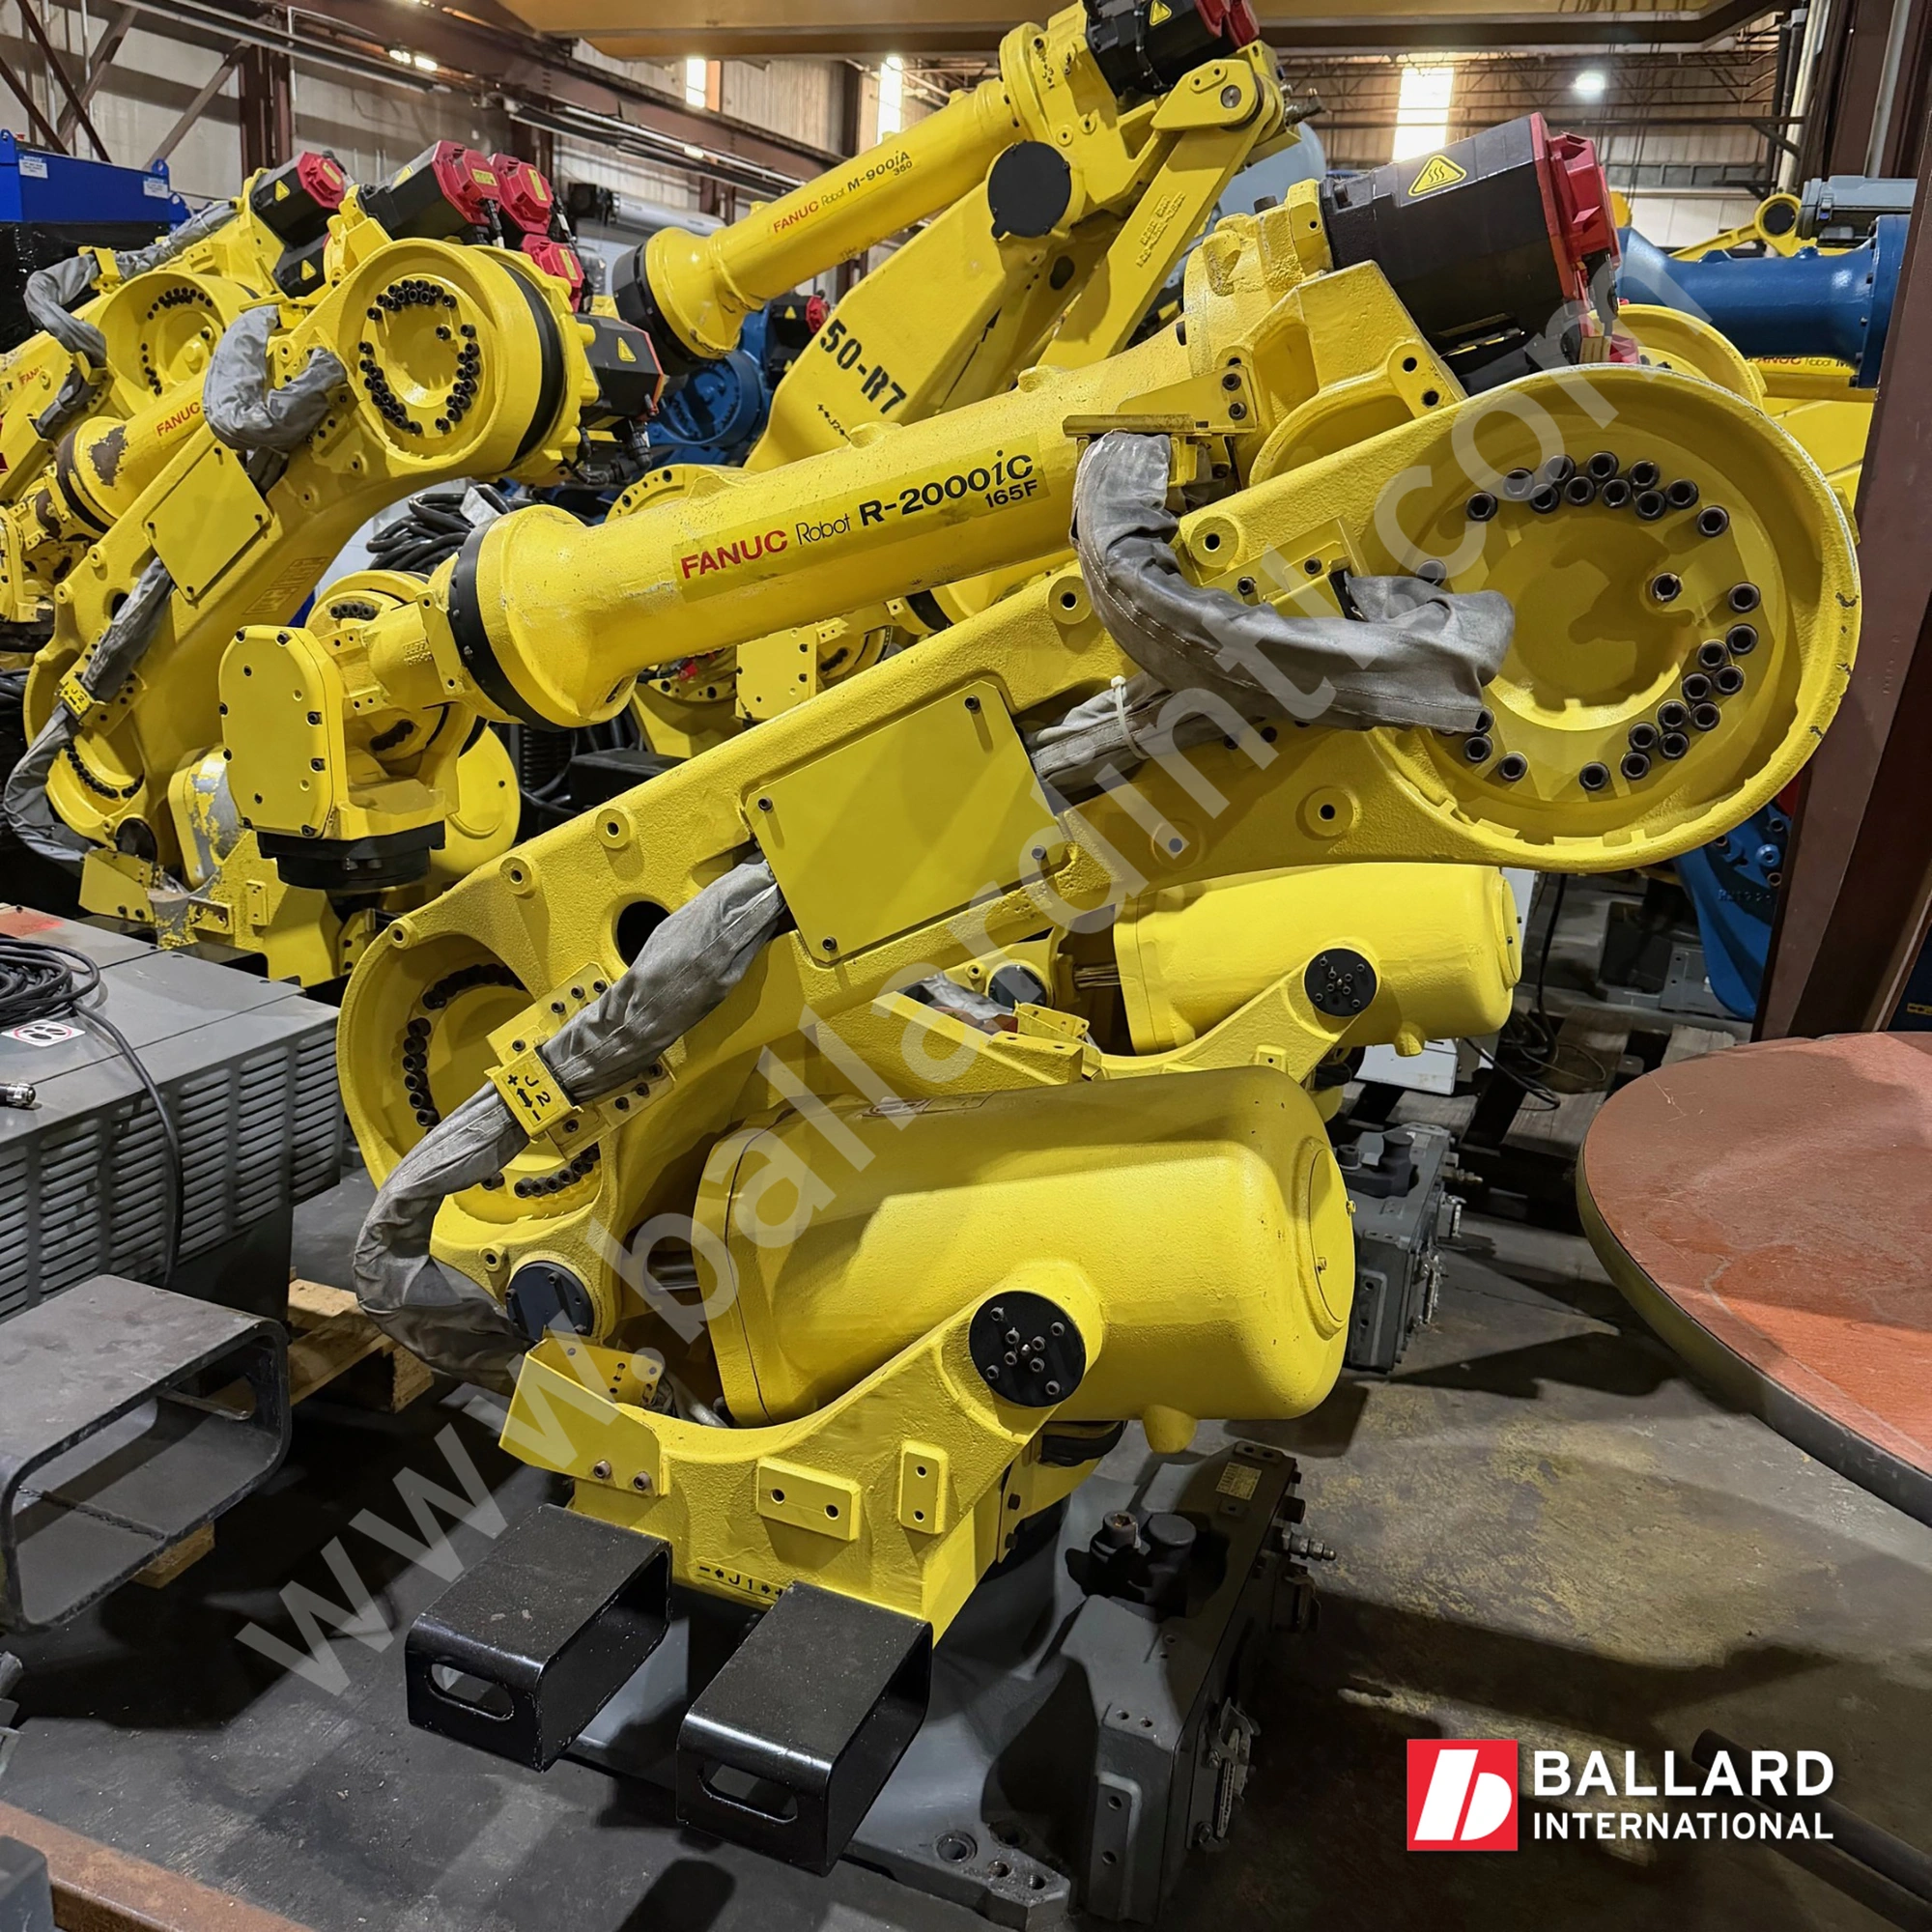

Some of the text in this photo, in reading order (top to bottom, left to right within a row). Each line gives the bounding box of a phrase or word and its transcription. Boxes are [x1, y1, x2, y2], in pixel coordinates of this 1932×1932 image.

[773, 150, 911, 234] FANUC Robot M-900iA
[156, 402, 201, 438] FANUC
[828, 418, 841, 432] J2
[983, 479, 1038, 508] 165F
[680, 449, 1034, 580] FANUC Robot R-2000iC
[525, 1075, 552, 1107] J2
[728, 1574, 753, 1590] J1
